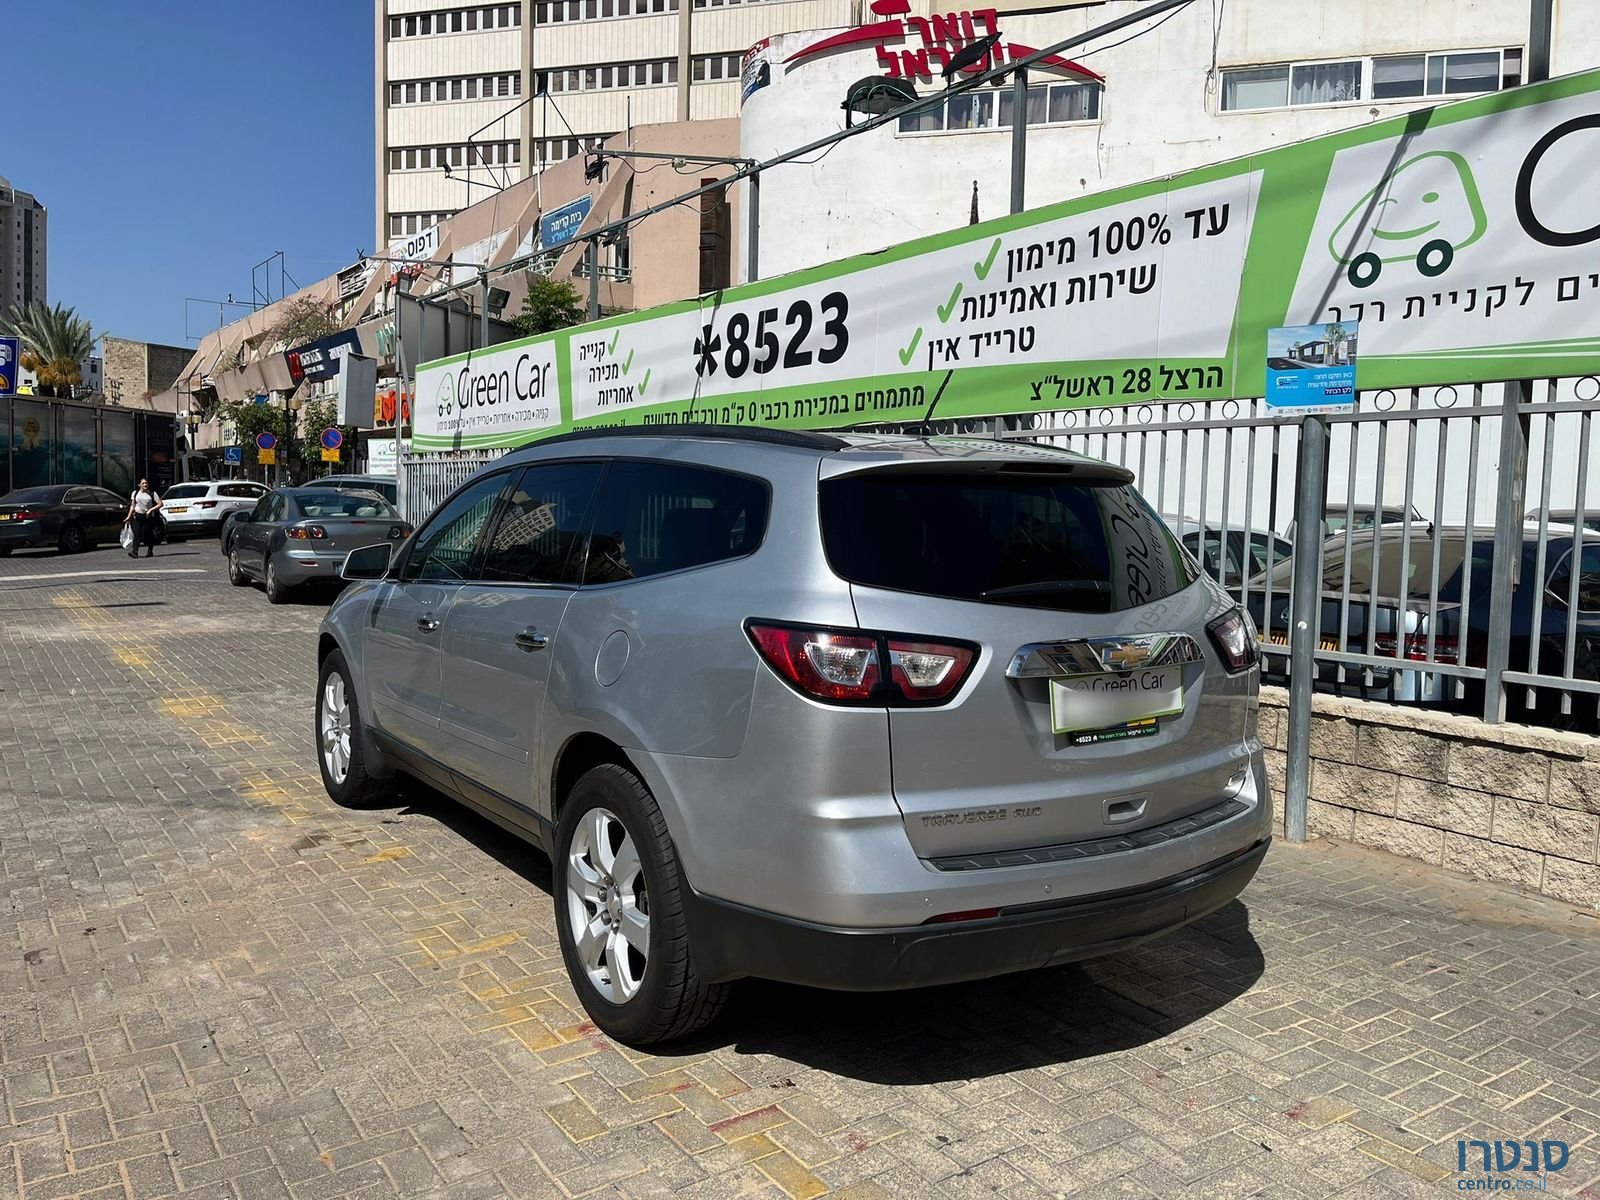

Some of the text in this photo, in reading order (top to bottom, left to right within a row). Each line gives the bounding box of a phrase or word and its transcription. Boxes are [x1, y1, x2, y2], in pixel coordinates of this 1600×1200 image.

[907, 9, 998, 44] דואר
[407, 232, 432, 257] דפוס
[1006, 203, 1230, 283] עד 100% מימון
[960, 264, 1157, 322] שירות ואמינות
[1402, 276, 1536, 319] לקניית
[580, 341, 606, 362] קנייה
[928, 325, 1036, 371] טרייד אין
[457, 367, 509, 409] Green
[515, 353, 551, 401] Car
[589, 363, 619, 383] מכירה
[1122, 367, 1151, 394] 28
[1159, 365, 1223, 391] הרצל
[598, 386, 634, 406] אחריות
[793, 394, 849, 418] במכירת
[855, 385, 924, 411] מתמחים
[749, 401, 757, 422] 0
[760, 403, 789, 421] רכבי
[1092, 671, 1165, 692] Green Car
[921, 808, 1008, 828] TRAVERSE
